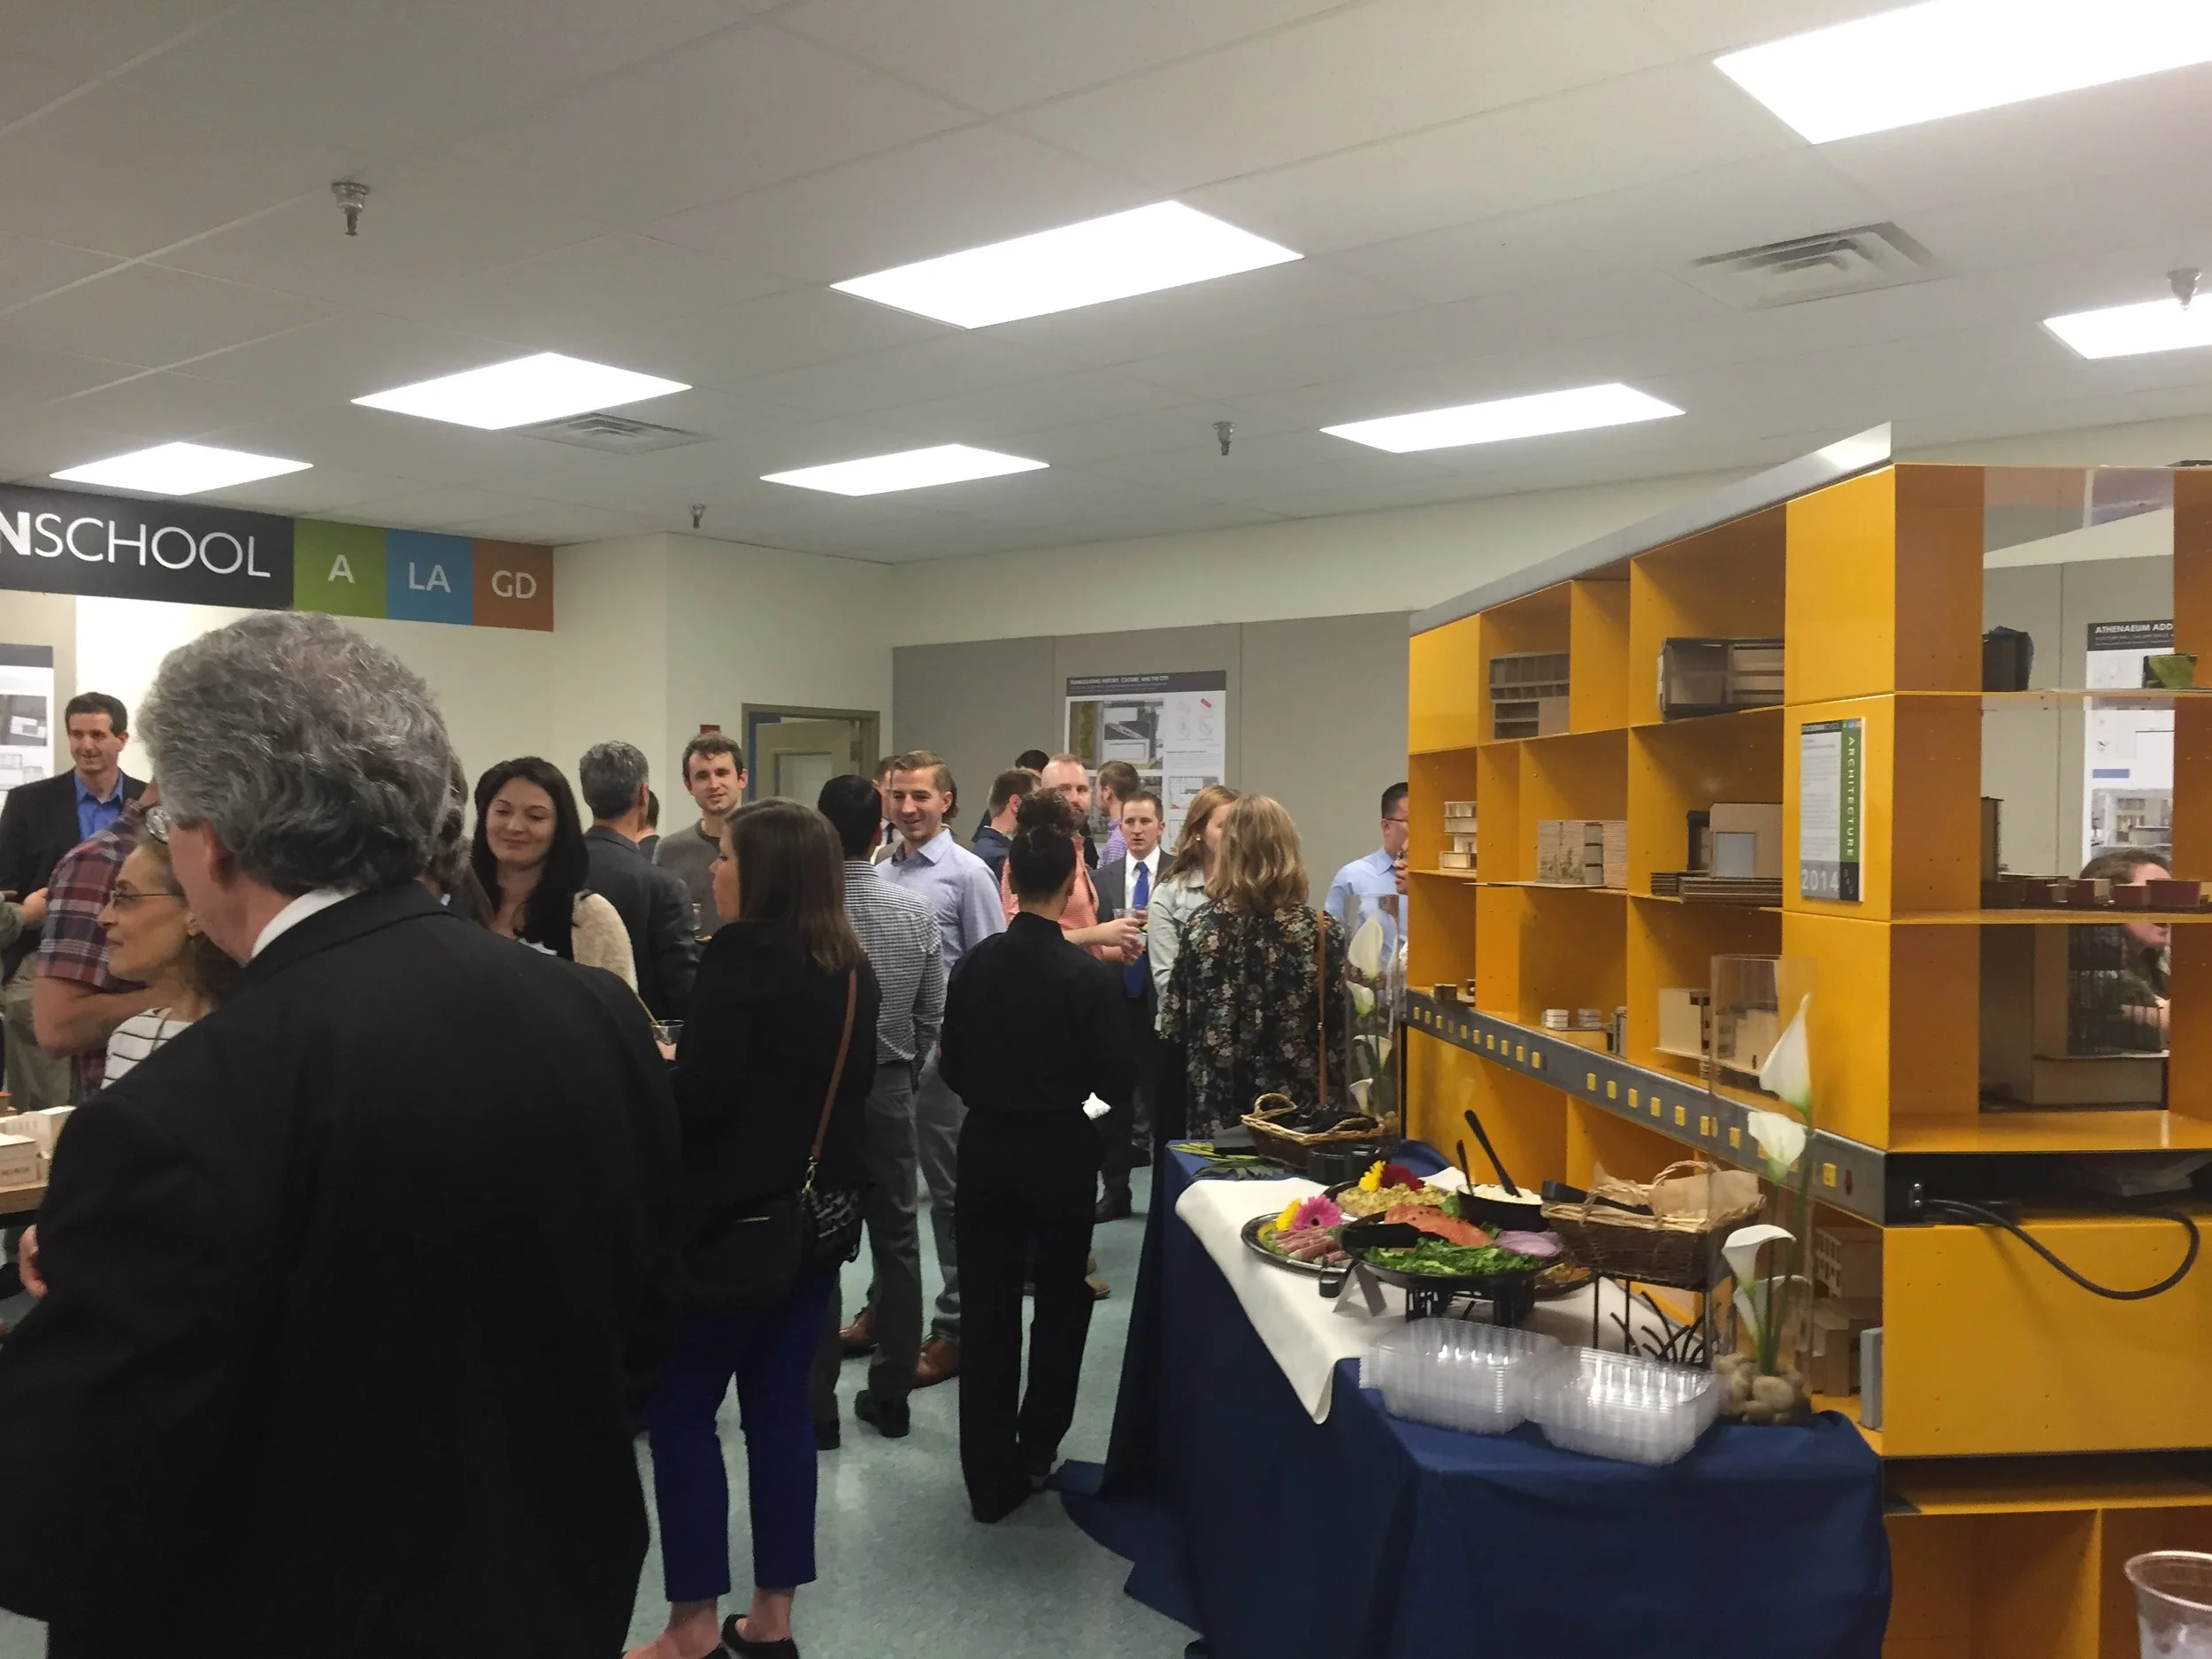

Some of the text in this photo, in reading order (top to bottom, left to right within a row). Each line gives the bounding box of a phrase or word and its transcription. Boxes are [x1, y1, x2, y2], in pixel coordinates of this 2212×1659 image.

[327, 554, 355, 584] A
[409, 561, 452, 594] LA
[491, 570, 538, 599] GD
[2095, 624, 2151, 634] ATHENAEUM
[1847, 736, 1855, 856] ARCHITECTURE
[1801, 868, 1840, 893] 2014
